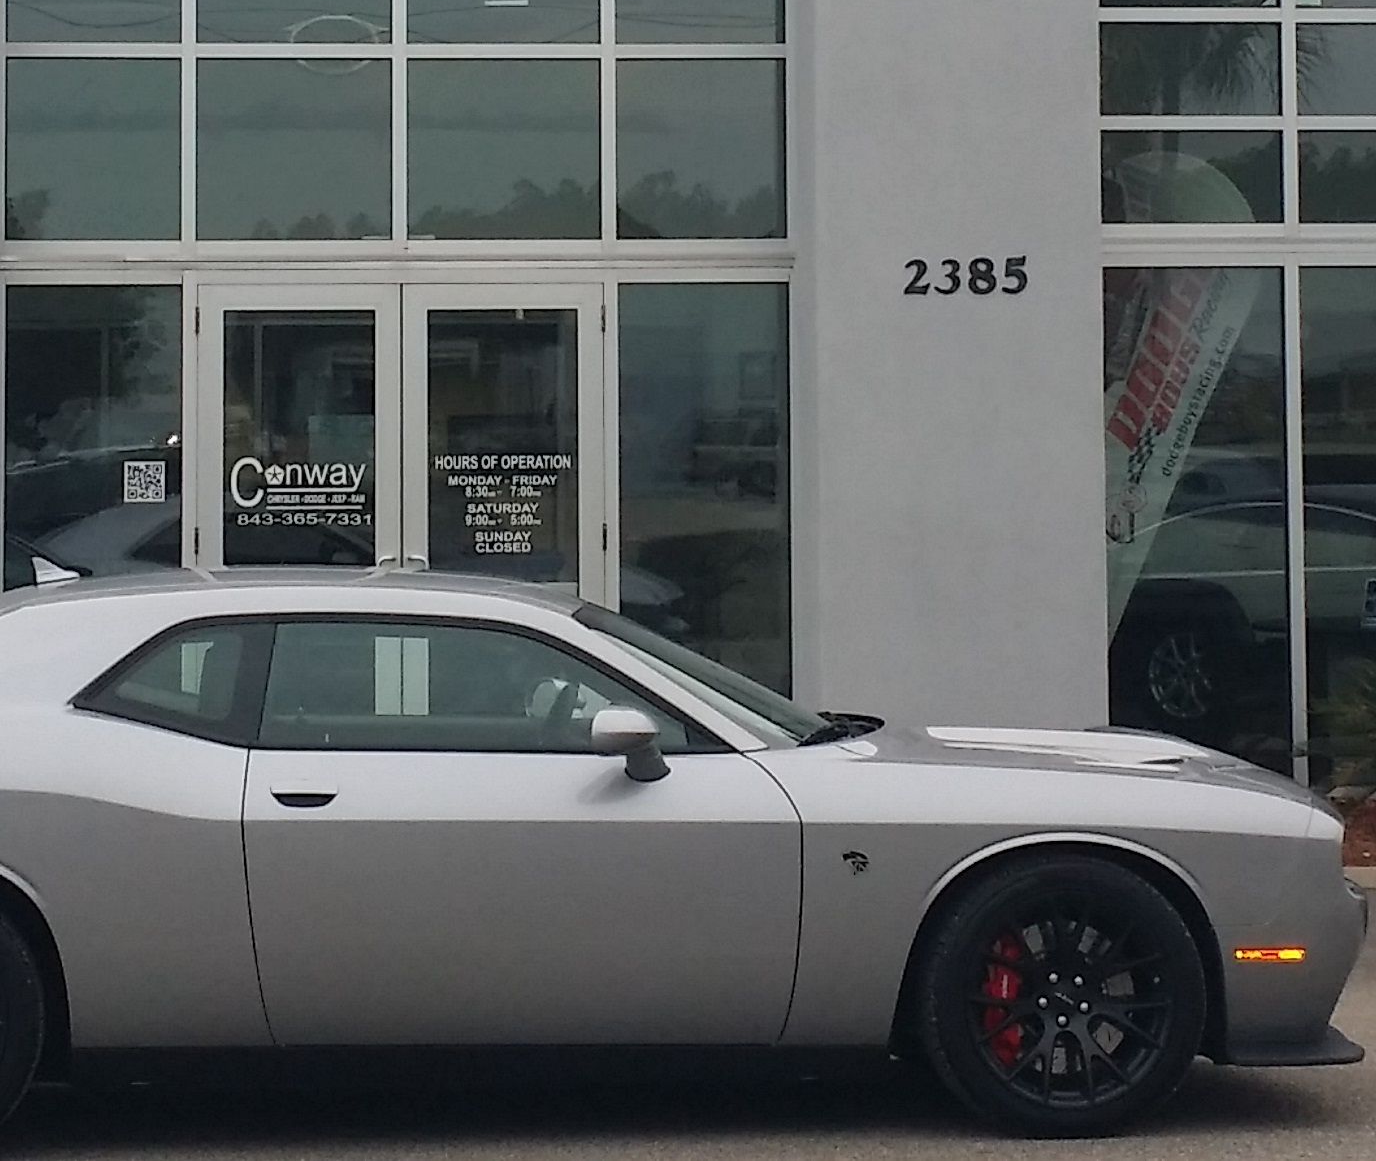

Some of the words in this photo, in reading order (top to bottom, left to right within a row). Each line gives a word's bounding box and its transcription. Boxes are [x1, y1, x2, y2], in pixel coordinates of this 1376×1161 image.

[903, 255, 1028, 295] 2385
[434, 455, 479, 470] HOURS
[480, 455, 499, 470] OF
[501, 454, 572, 470] OPERATION
[447, 475, 503, 486] MONDAY
[512, 475, 558, 486] FRIDAY
[467, 502, 539, 514] SATURDAY
[236, 512, 372, 526] 843-365-7331
[474, 531, 531, 542] SUNDAY
[475, 542, 532, 553] CLOSED
